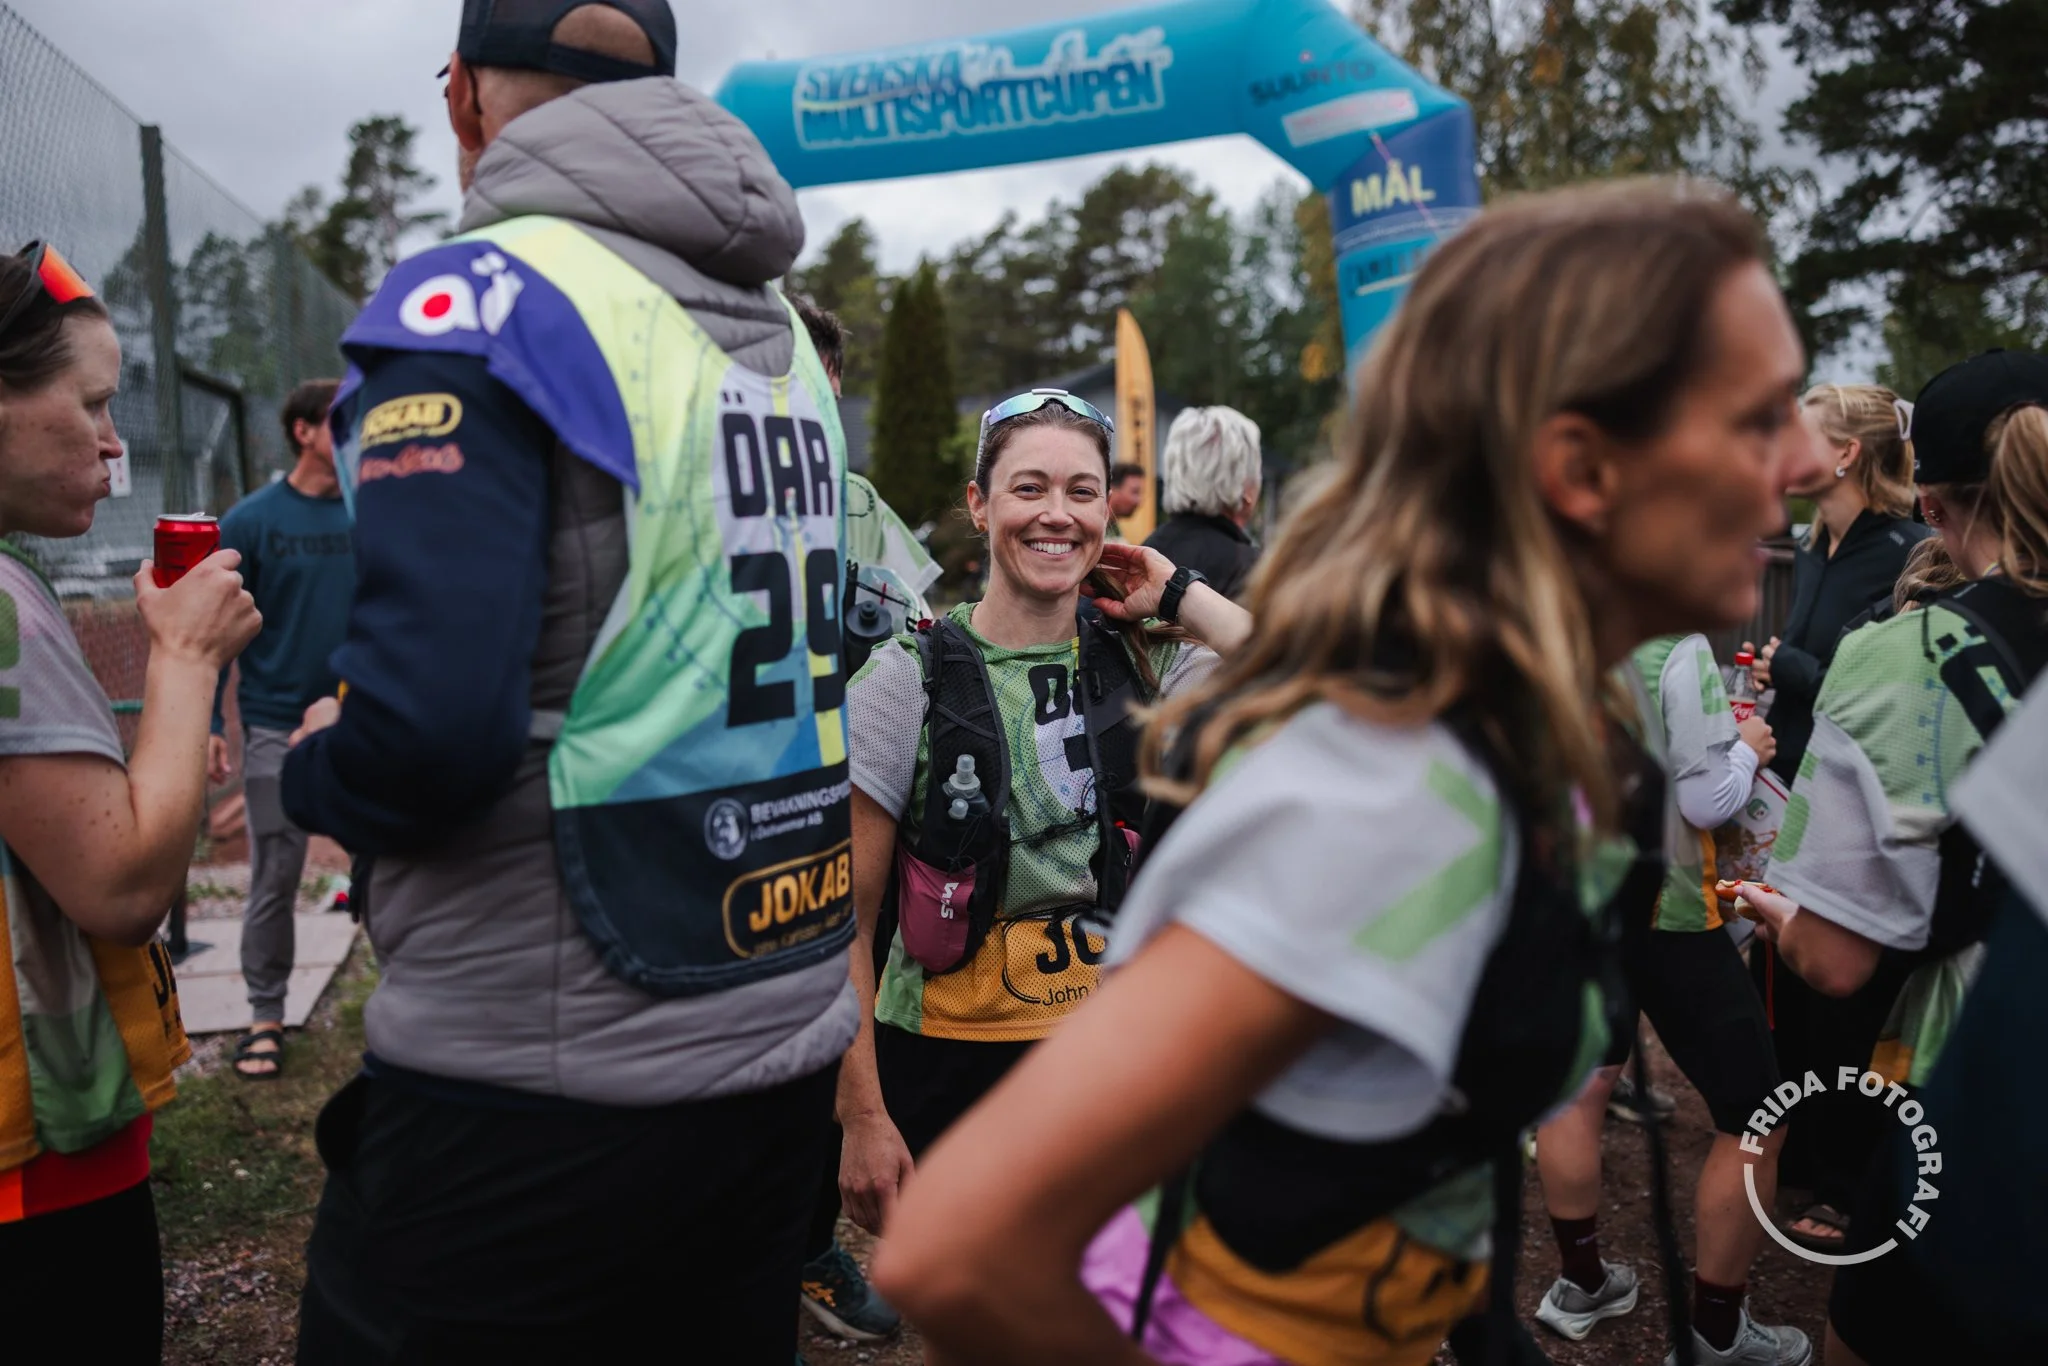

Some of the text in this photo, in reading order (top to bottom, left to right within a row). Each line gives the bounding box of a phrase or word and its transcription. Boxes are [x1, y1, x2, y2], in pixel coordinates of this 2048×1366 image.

[1352, 158, 1436, 217] MÅL
[725, 548, 847, 729] 29
[749, 853, 850, 933] JOKAB
[1042, 985, 1089, 1006] John
